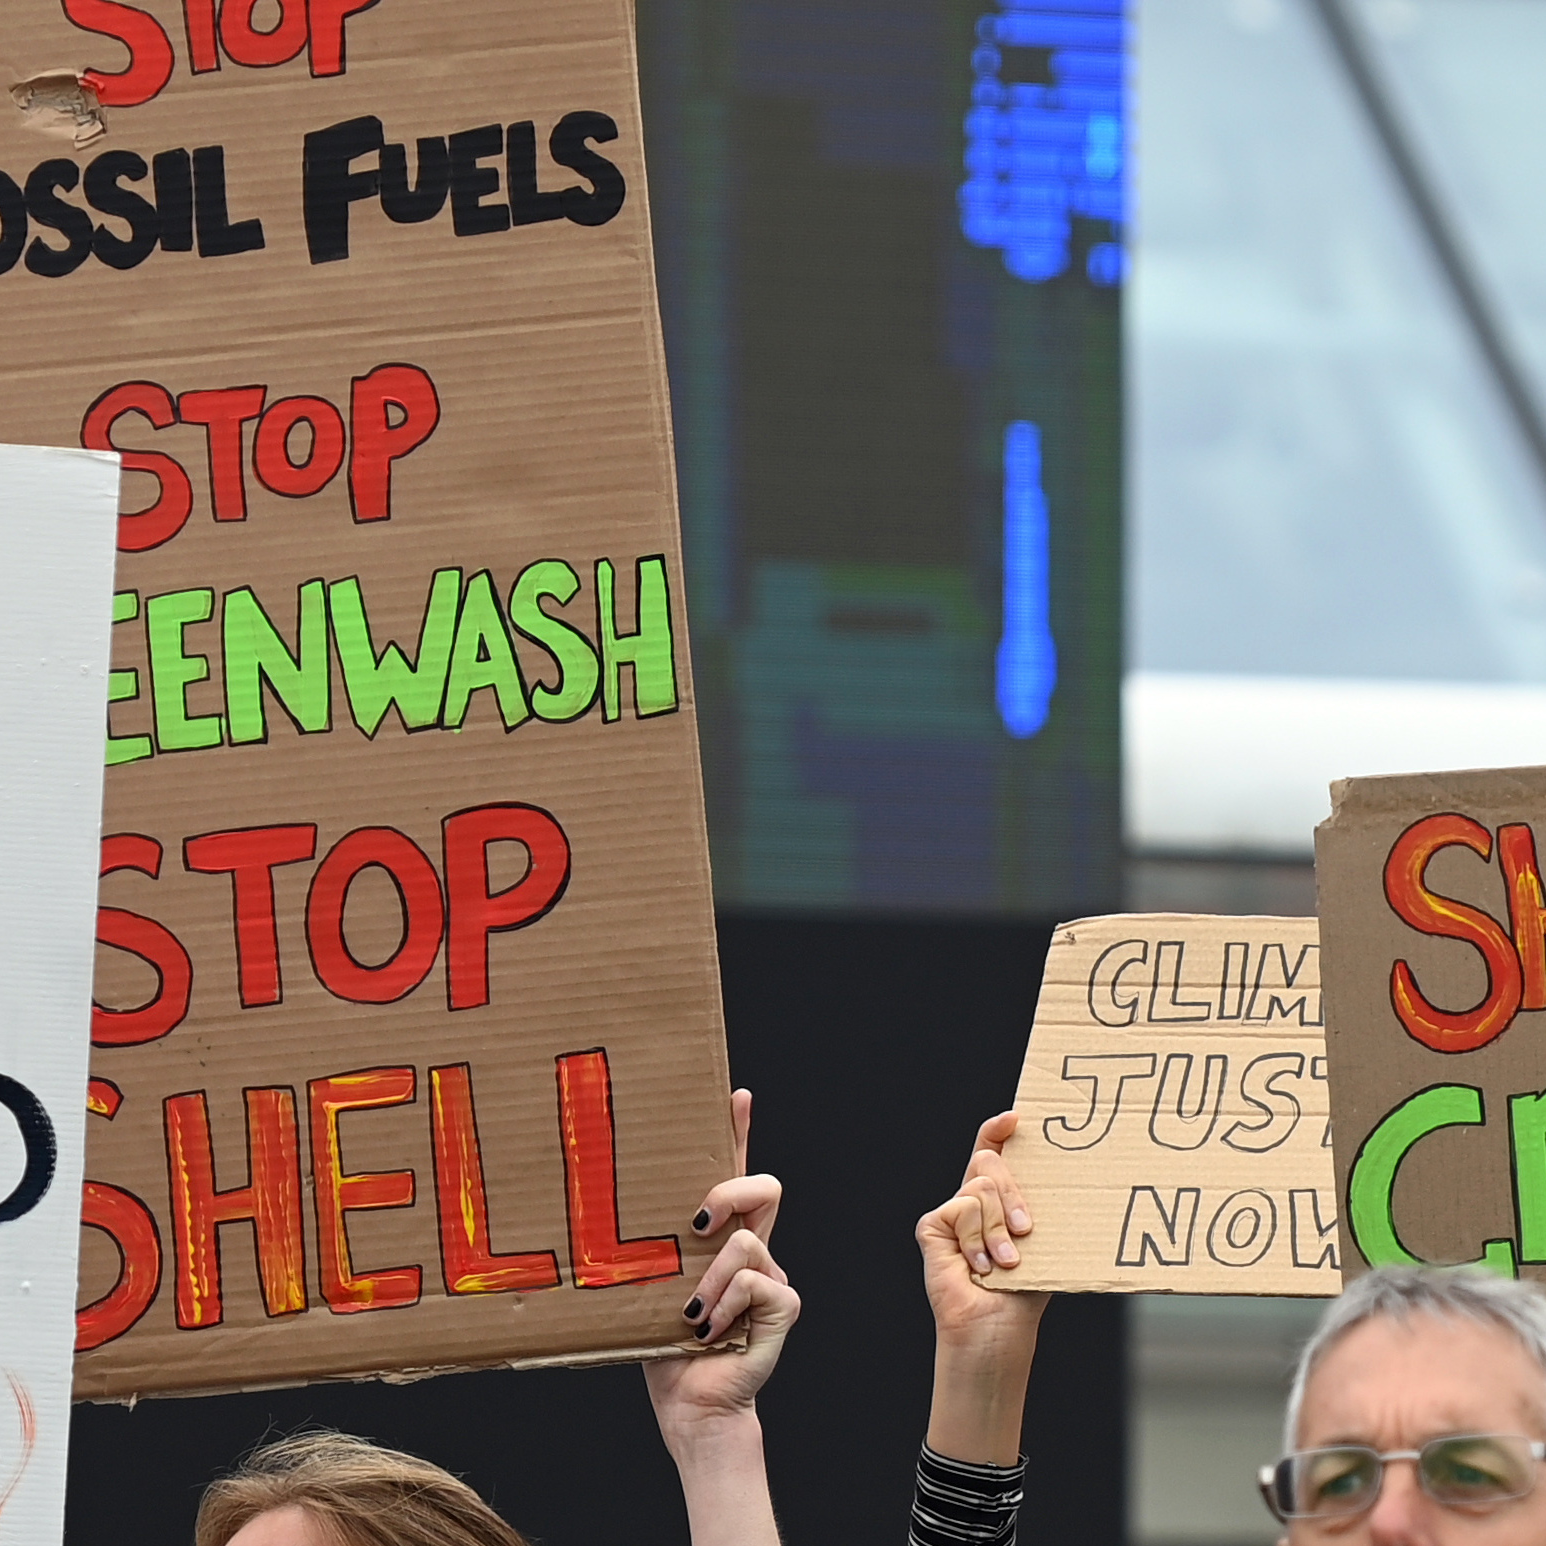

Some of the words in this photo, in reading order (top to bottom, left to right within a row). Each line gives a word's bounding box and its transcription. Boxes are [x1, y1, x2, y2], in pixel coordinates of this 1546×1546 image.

[303, 111, 626, 265] FUELS
[80, 363, 440, 552] STOP
[90, 801, 571, 1048] STOP
